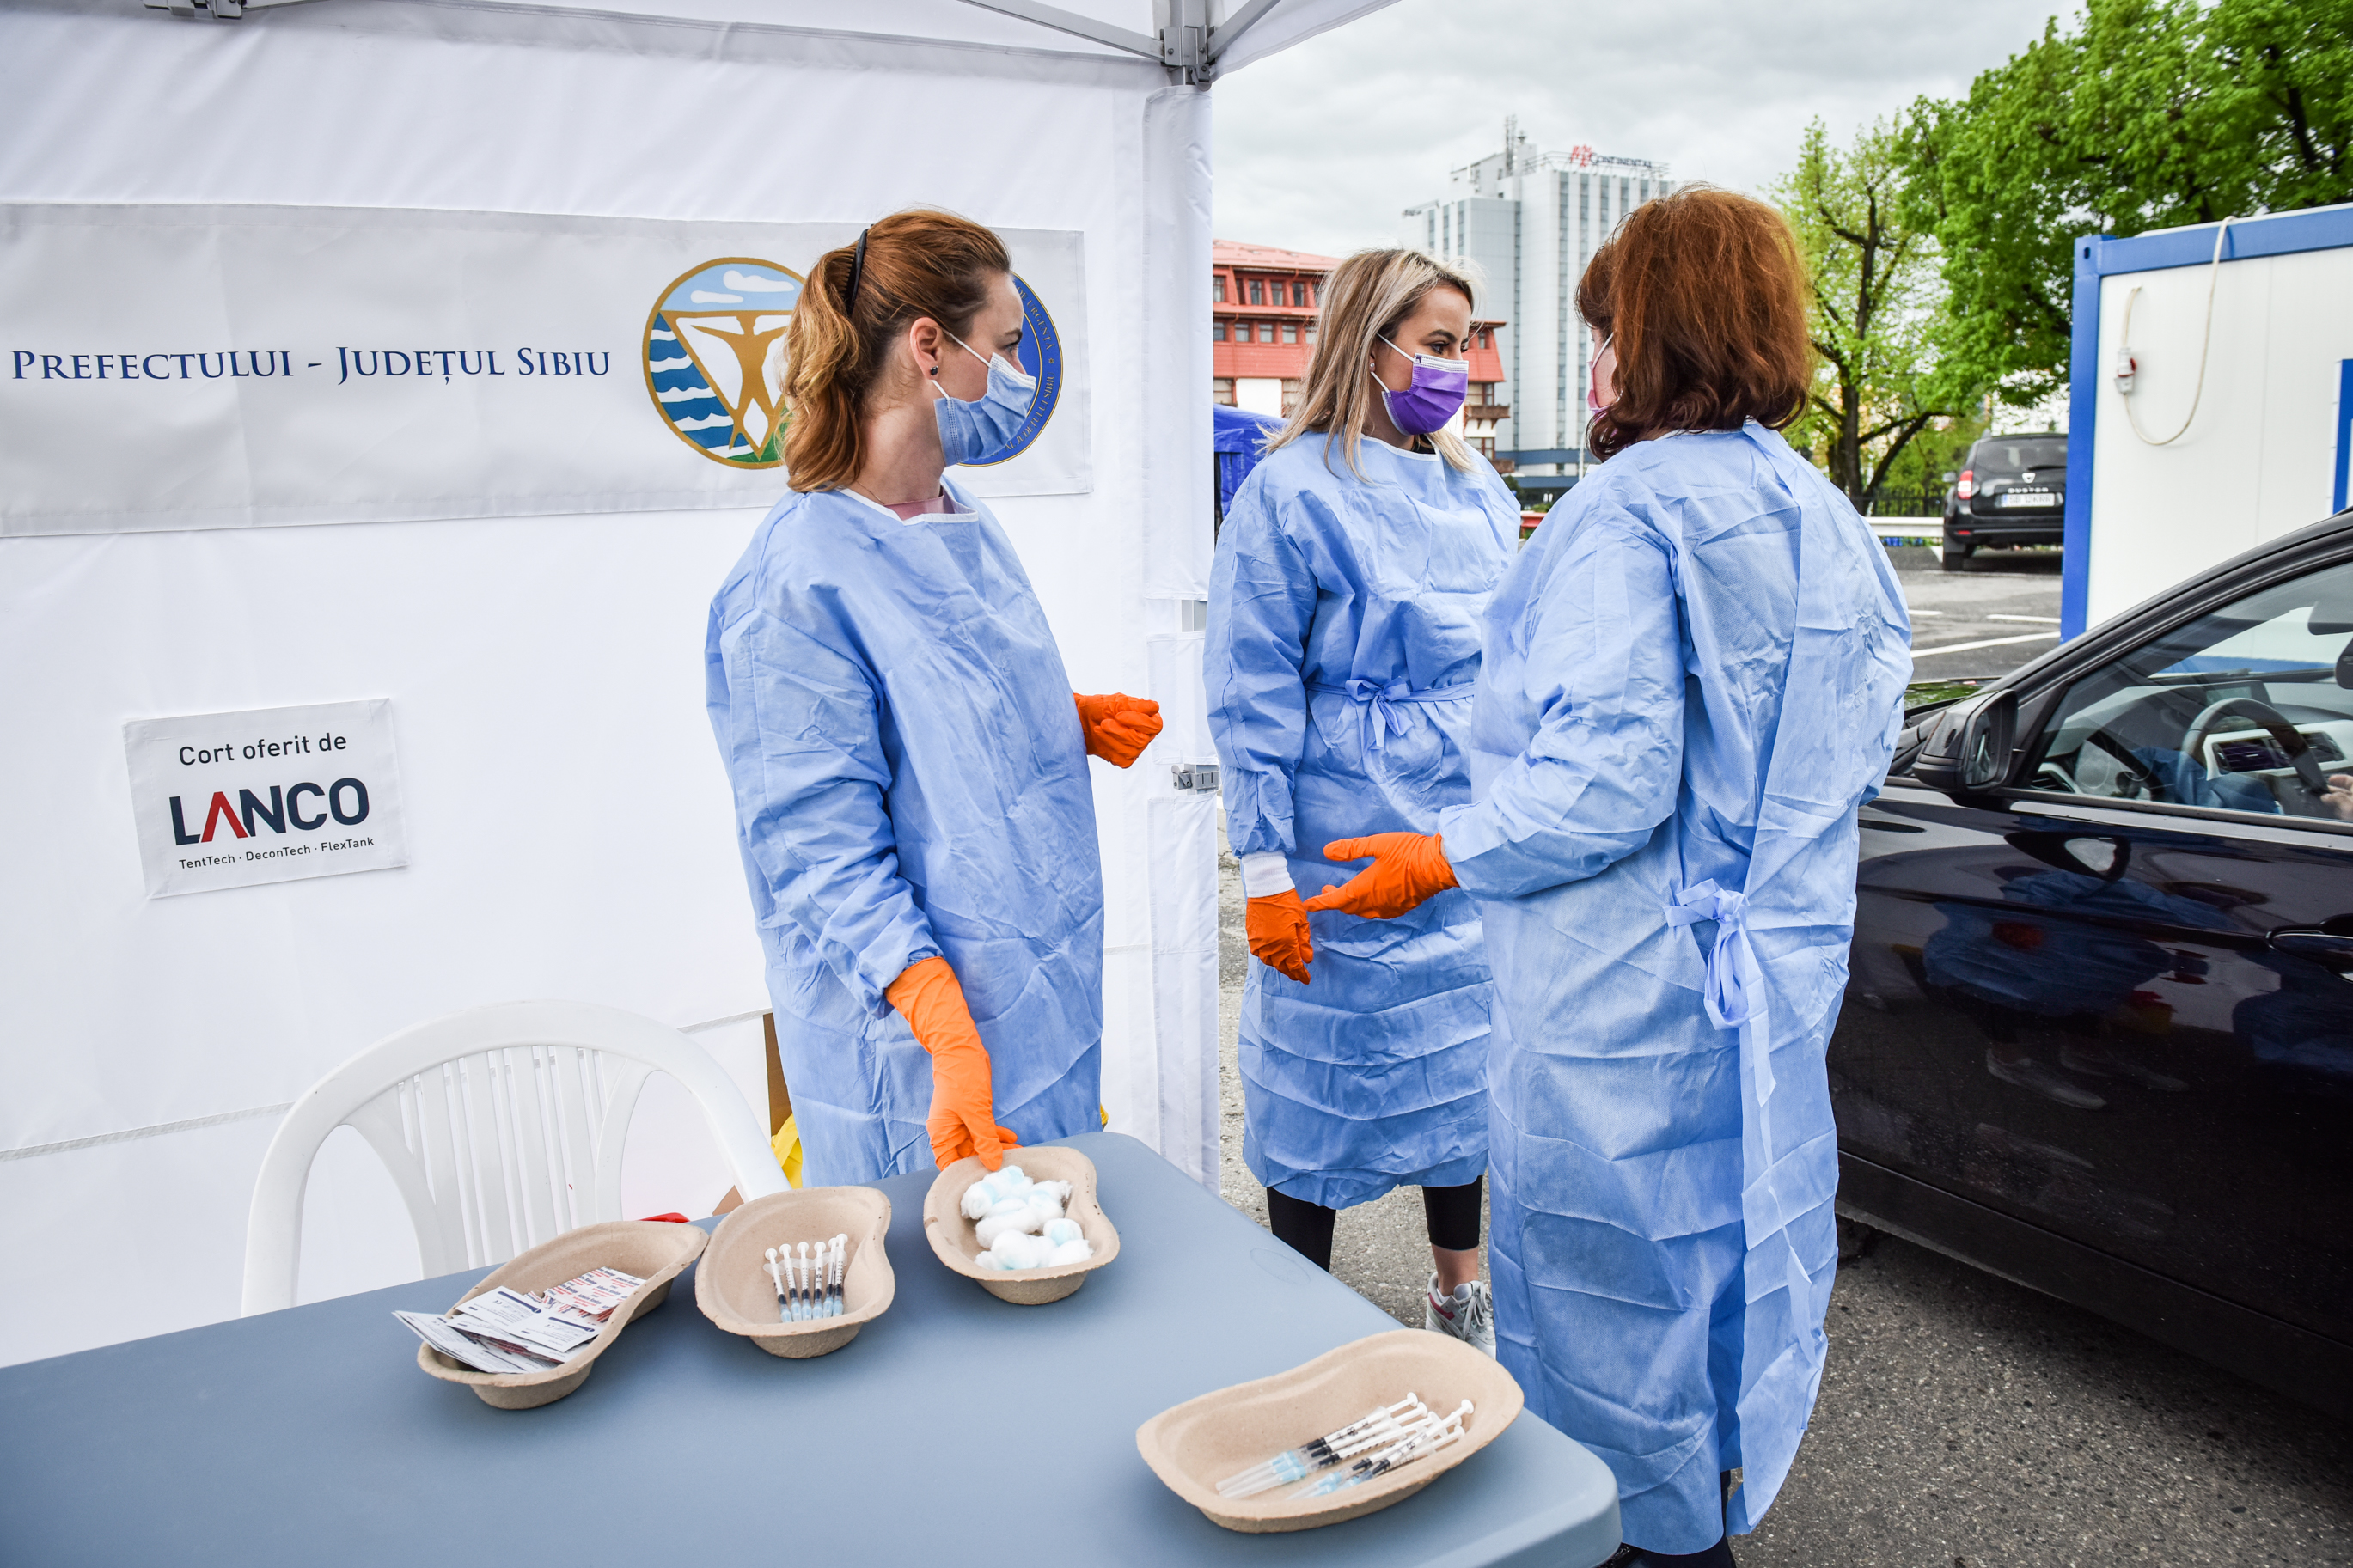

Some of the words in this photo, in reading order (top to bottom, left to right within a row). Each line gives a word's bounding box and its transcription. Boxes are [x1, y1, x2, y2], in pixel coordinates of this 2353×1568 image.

[10, 350, 294, 380] PREFECTULUI
[517, 347, 610, 376] SIBIU
[179, 743, 235, 766] Cort
[242, 735, 311, 760] oferit
[318, 732, 347, 752] de
[169, 777, 370, 846] LANCO
[179, 854, 236, 869] TentTech
[245, 845, 311, 862] DeconTech
[321, 837, 375, 852] FlexTank
